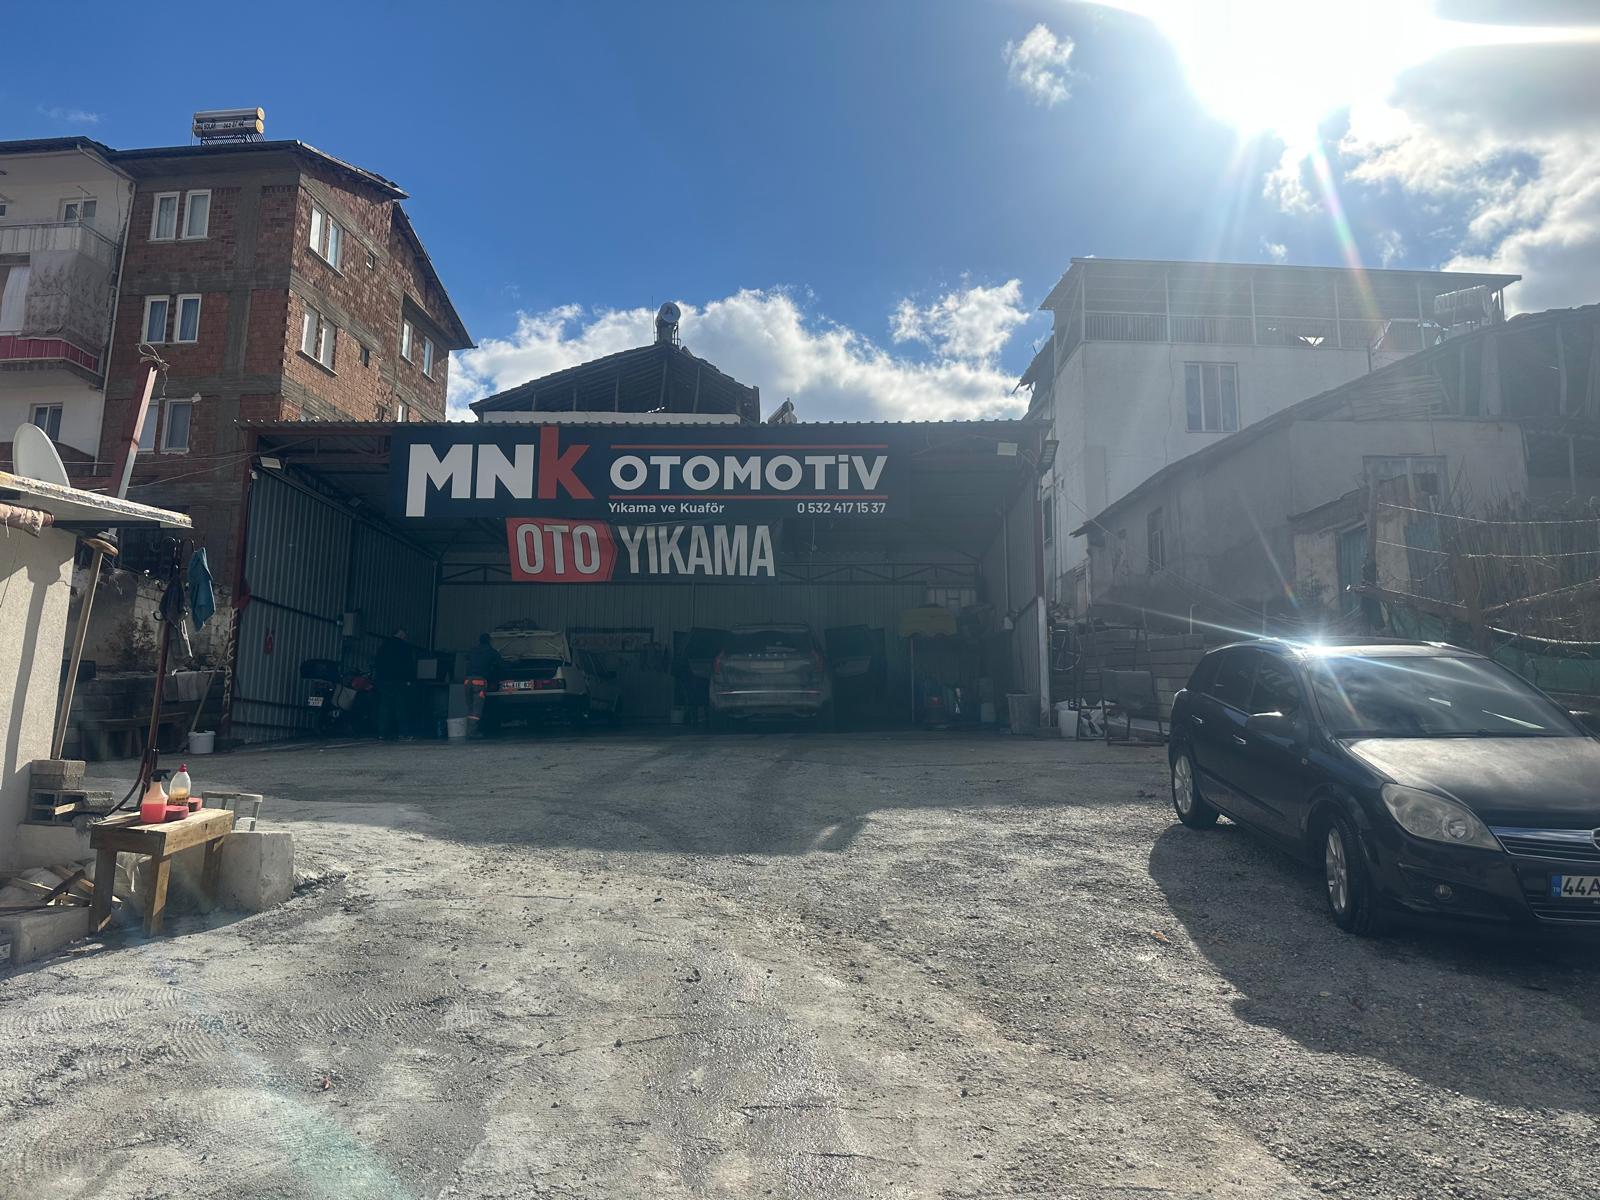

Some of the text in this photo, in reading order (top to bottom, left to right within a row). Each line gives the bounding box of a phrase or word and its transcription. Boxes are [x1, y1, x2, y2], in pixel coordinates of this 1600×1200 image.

[608, 502, 725, 513] Yıkama ve Kuaför
[797, 502, 886, 513] 0 532 417 15 37
[516, 523, 776, 577] OTO YIKAMA
